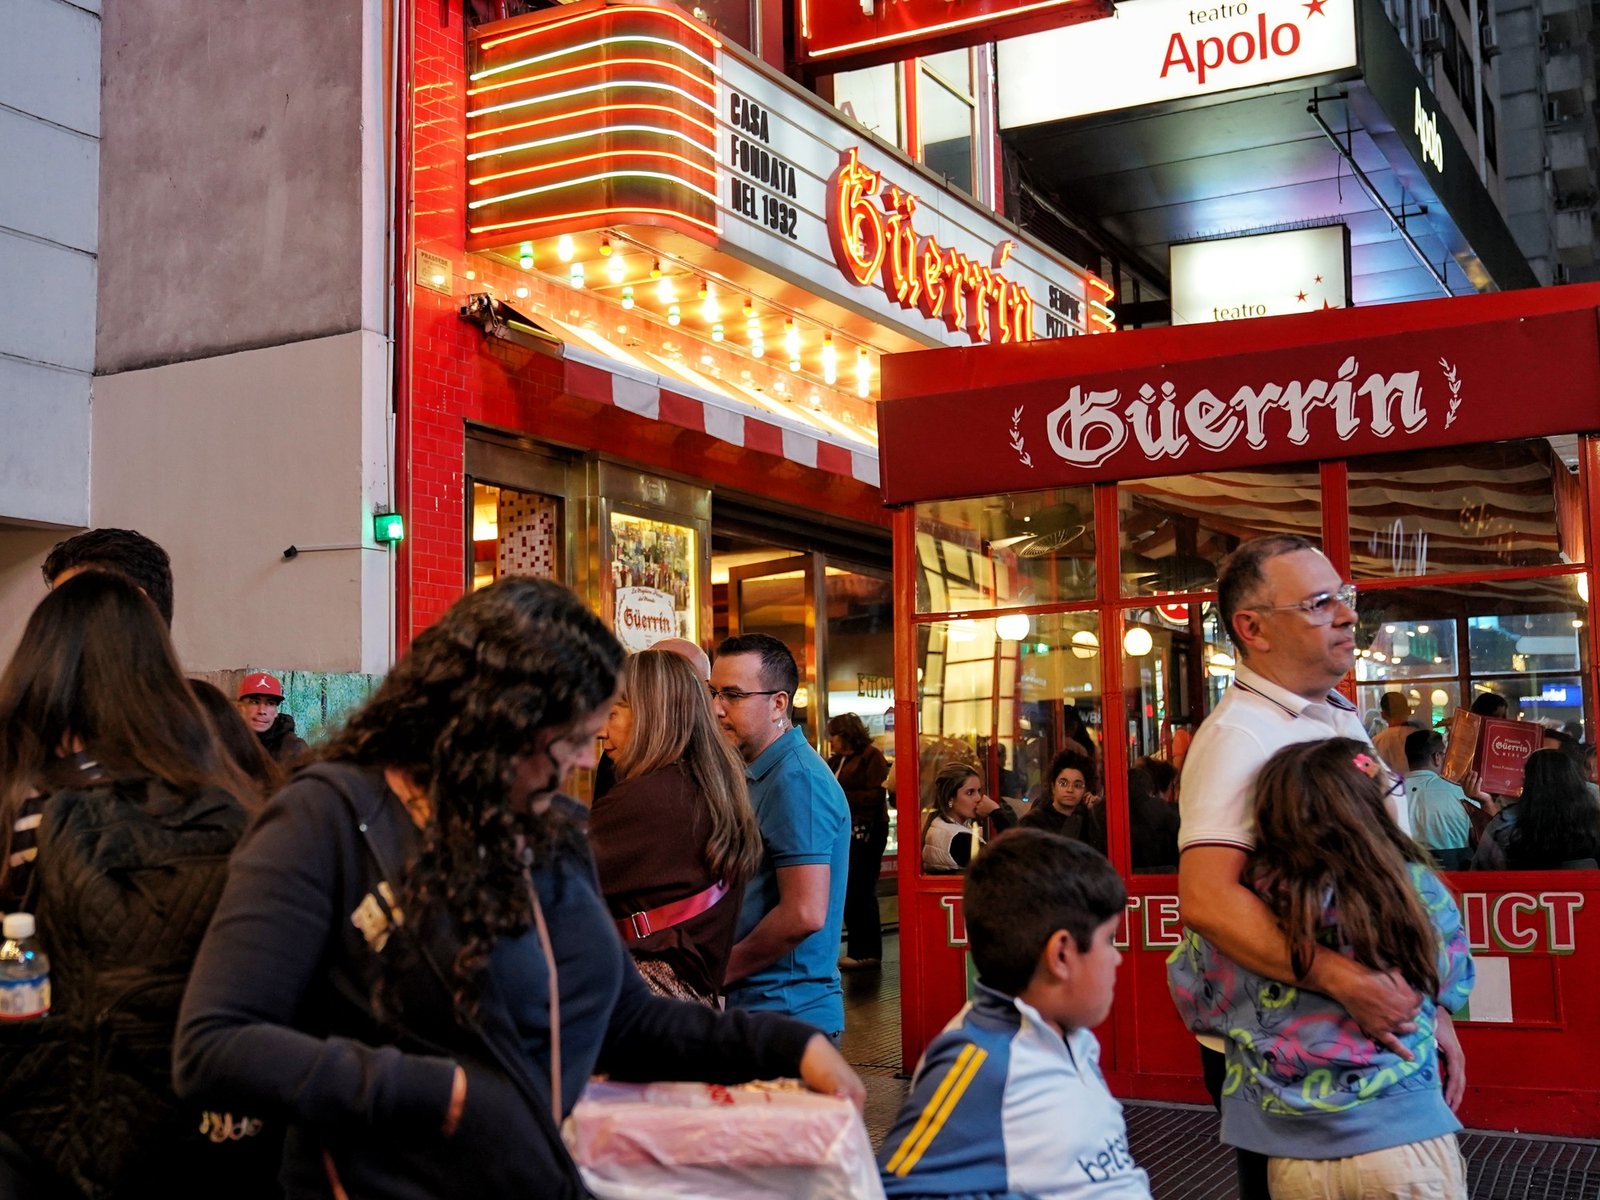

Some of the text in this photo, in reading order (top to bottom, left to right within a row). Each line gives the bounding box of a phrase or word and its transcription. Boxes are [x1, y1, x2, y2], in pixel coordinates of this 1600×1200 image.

[1189, 2, 1248, 25] teatro
[1160, 12, 1301, 85] Apolo
[731, 93, 769, 143] CASA
[1415, 86, 1444, 173] Apolo
[731, 134, 797, 199] FONDATA
[731, 177, 798, 240] NEL 1932
[1049, 285, 1080, 323] SEMPRE
[1213, 303, 1266, 321] teatro
